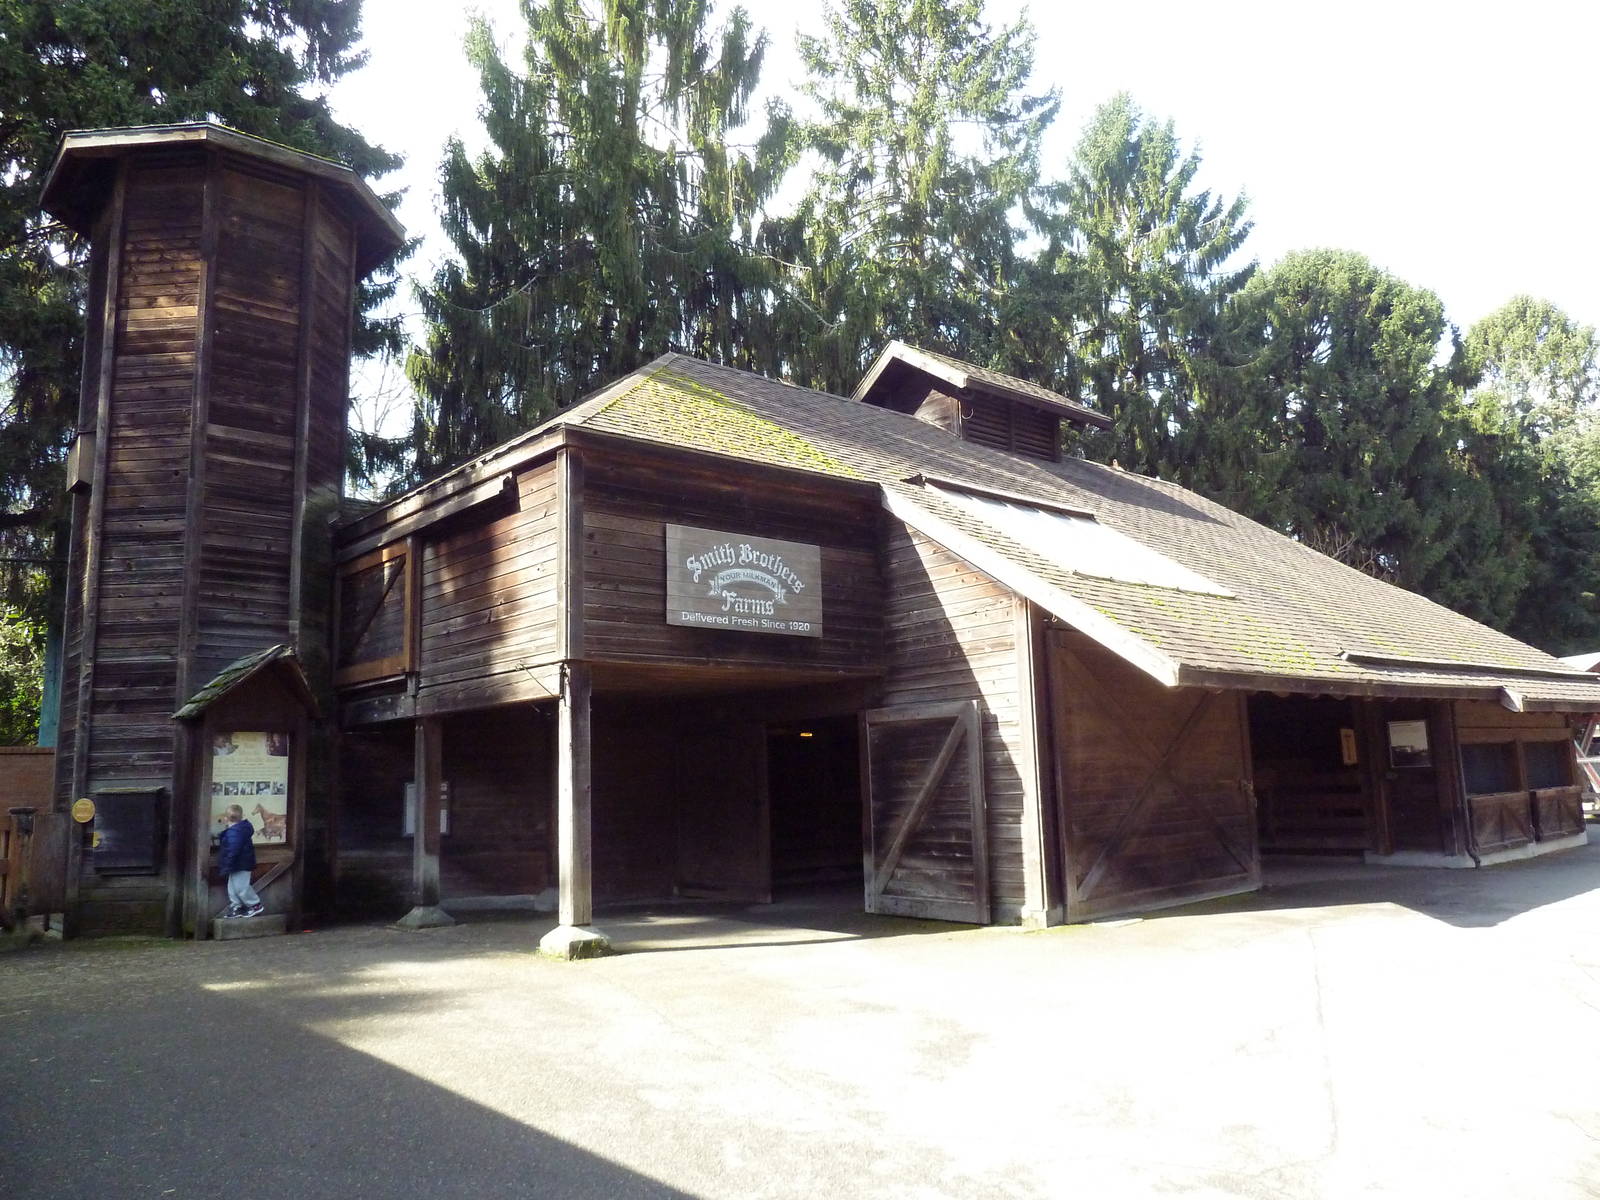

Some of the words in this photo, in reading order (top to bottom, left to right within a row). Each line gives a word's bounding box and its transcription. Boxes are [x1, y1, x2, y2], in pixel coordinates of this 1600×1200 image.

[686, 543, 736, 583] Smith
[738, 543, 806, 594] Brothers
[721, 590, 775, 615] Farms
[681, 611, 729, 625] Delivered
[731, 616, 759, 628] Fresh
[761, 618, 786, 630] Since
[789, 621, 810, 631] 1920
